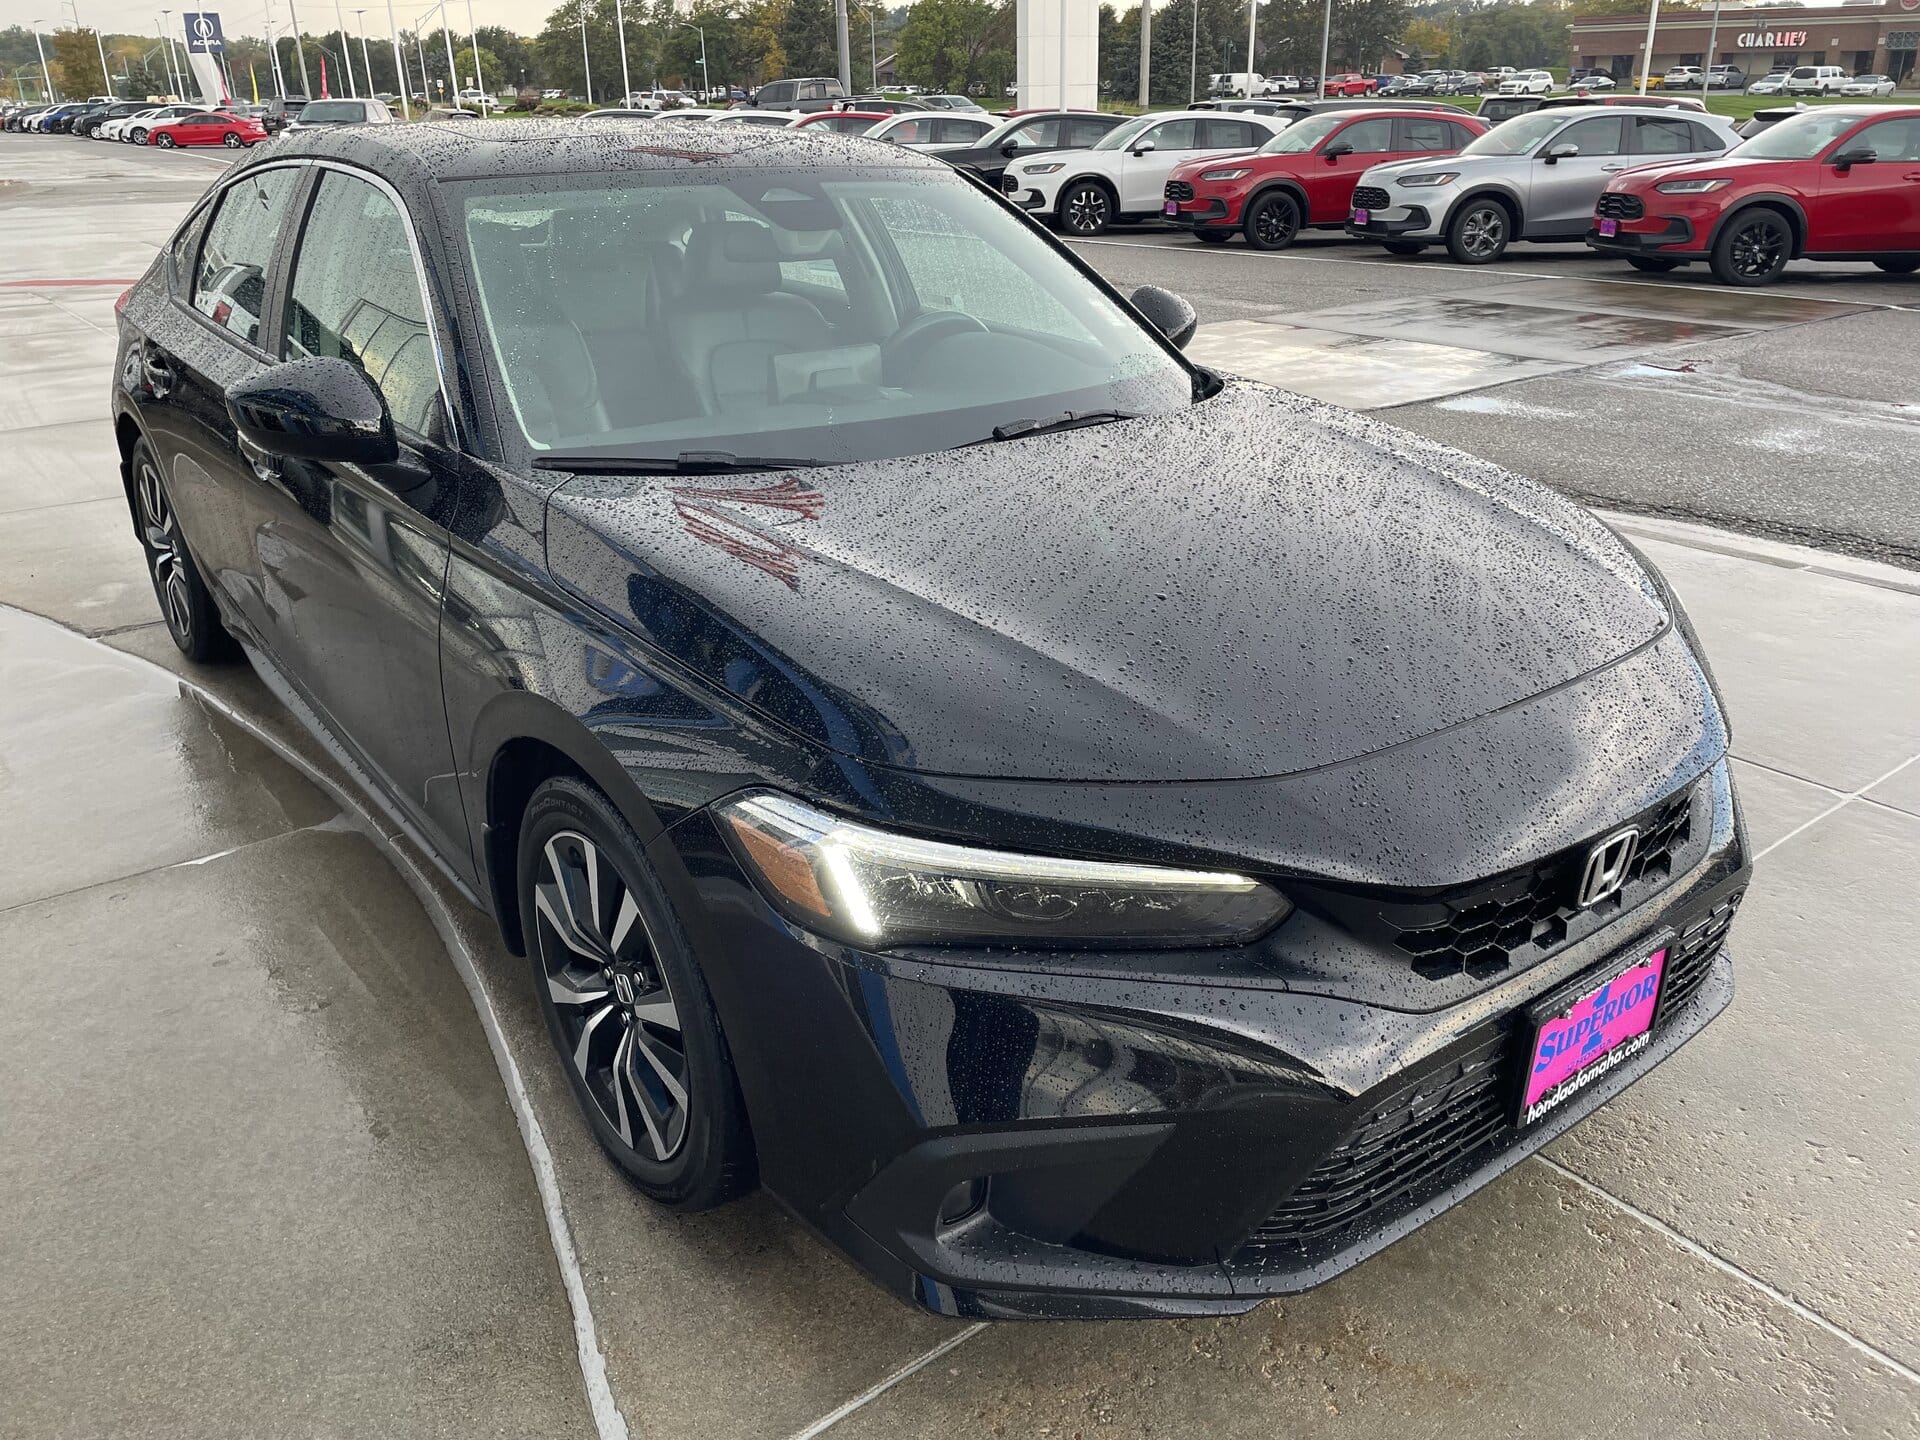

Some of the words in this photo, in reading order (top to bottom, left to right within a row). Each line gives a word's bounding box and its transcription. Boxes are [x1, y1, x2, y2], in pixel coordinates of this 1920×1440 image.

[1737, 31, 1808, 47] CHARLIE'S
[1534, 974, 1658, 1073] SUPERIOR
[1526, 1032, 1651, 1125] hondaofomaha.com
